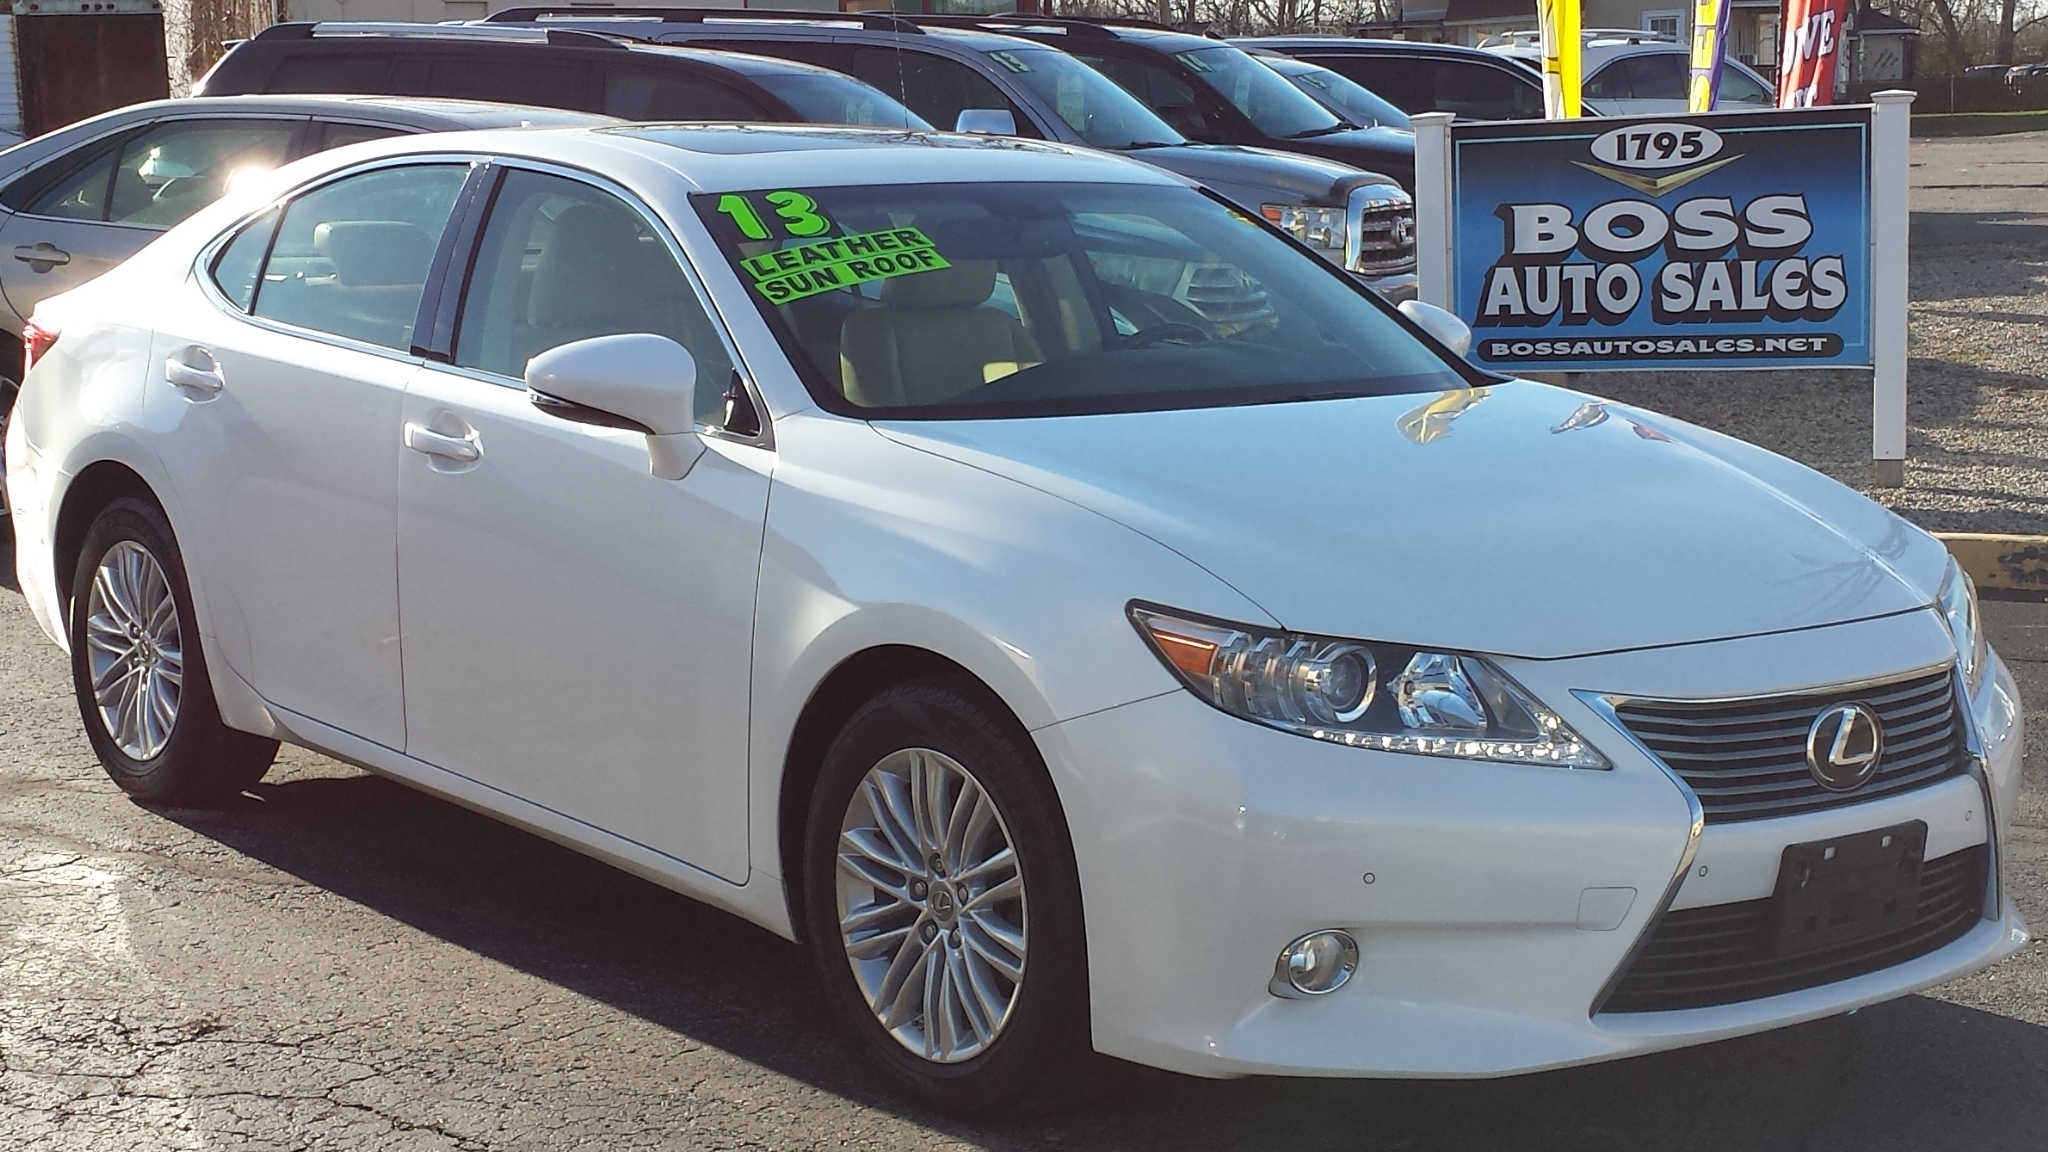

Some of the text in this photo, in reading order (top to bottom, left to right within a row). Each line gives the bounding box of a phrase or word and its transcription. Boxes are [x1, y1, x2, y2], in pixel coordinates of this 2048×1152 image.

[1614, 131, 1704, 162] 1795
[717, 190, 831, 240] 13
[1508, 193, 1814, 257] BOSS
[749, 230, 926, 277] LEATHER
[765, 250, 936, 300] SUN ROOF
[1483, 255, 1848, 317] AUTO SALES
[1491, 337, 1828, 357] BOSSAUTOSALES.NET
